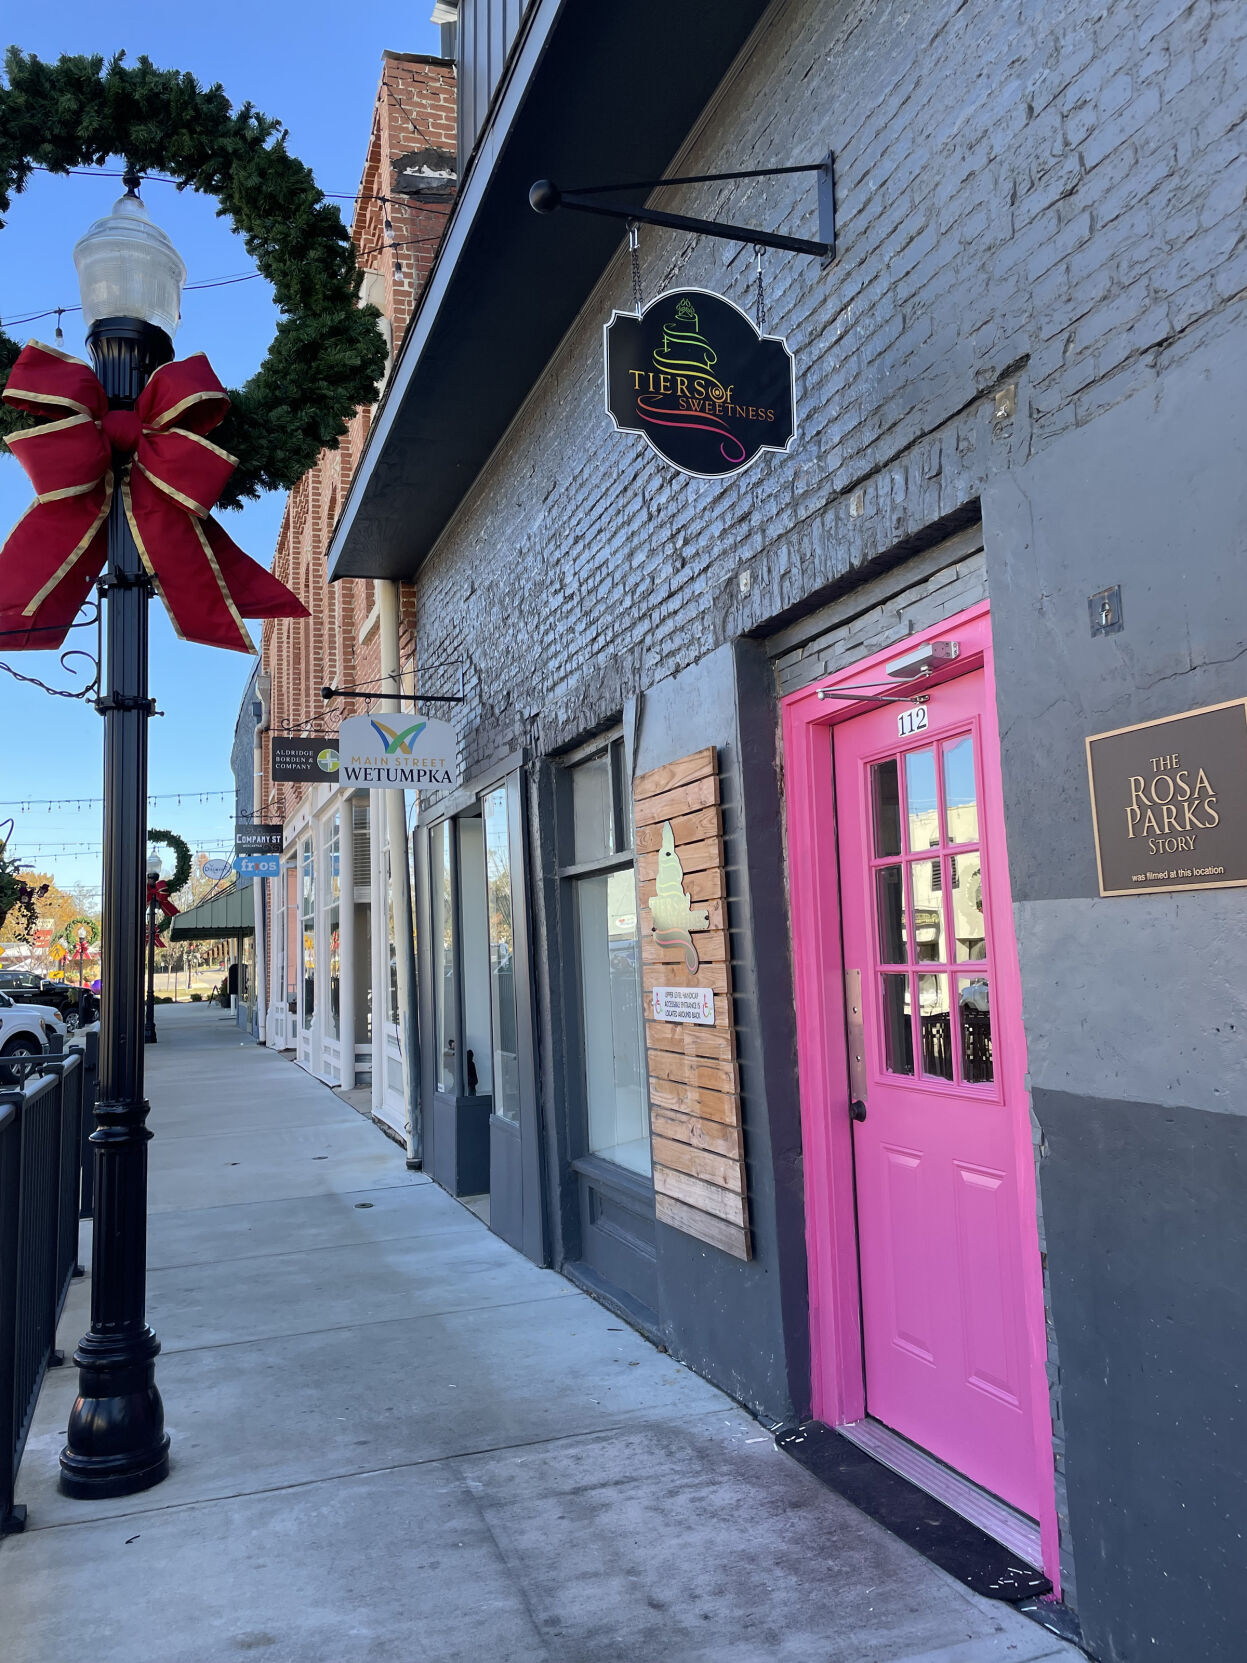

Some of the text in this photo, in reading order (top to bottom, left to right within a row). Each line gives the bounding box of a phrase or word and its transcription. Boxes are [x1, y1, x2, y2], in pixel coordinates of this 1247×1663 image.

[629, 369, 706, 399] TIERS
[679, 397, 775, 421] SWEETNESS
[899, 707, 927, 737] 112
[275, 749, 314, 757] ALDRIDGE
[351, 756, 446, 768] MAIN STREET
[1149, 753, 1180, 773] THE
[344, 766, 453, 784] WETUMPKA
[1127, 767, 1217, 809] ROSA
[1124, 797, 1220, 839] PARKS
[236, 833, 282, 844] COMPANY ST
[1148, 834, 1197, 855] STORY
[240, 859, 277, 872] frios
[1131, 865, 1225, 882] was filmed at this location
